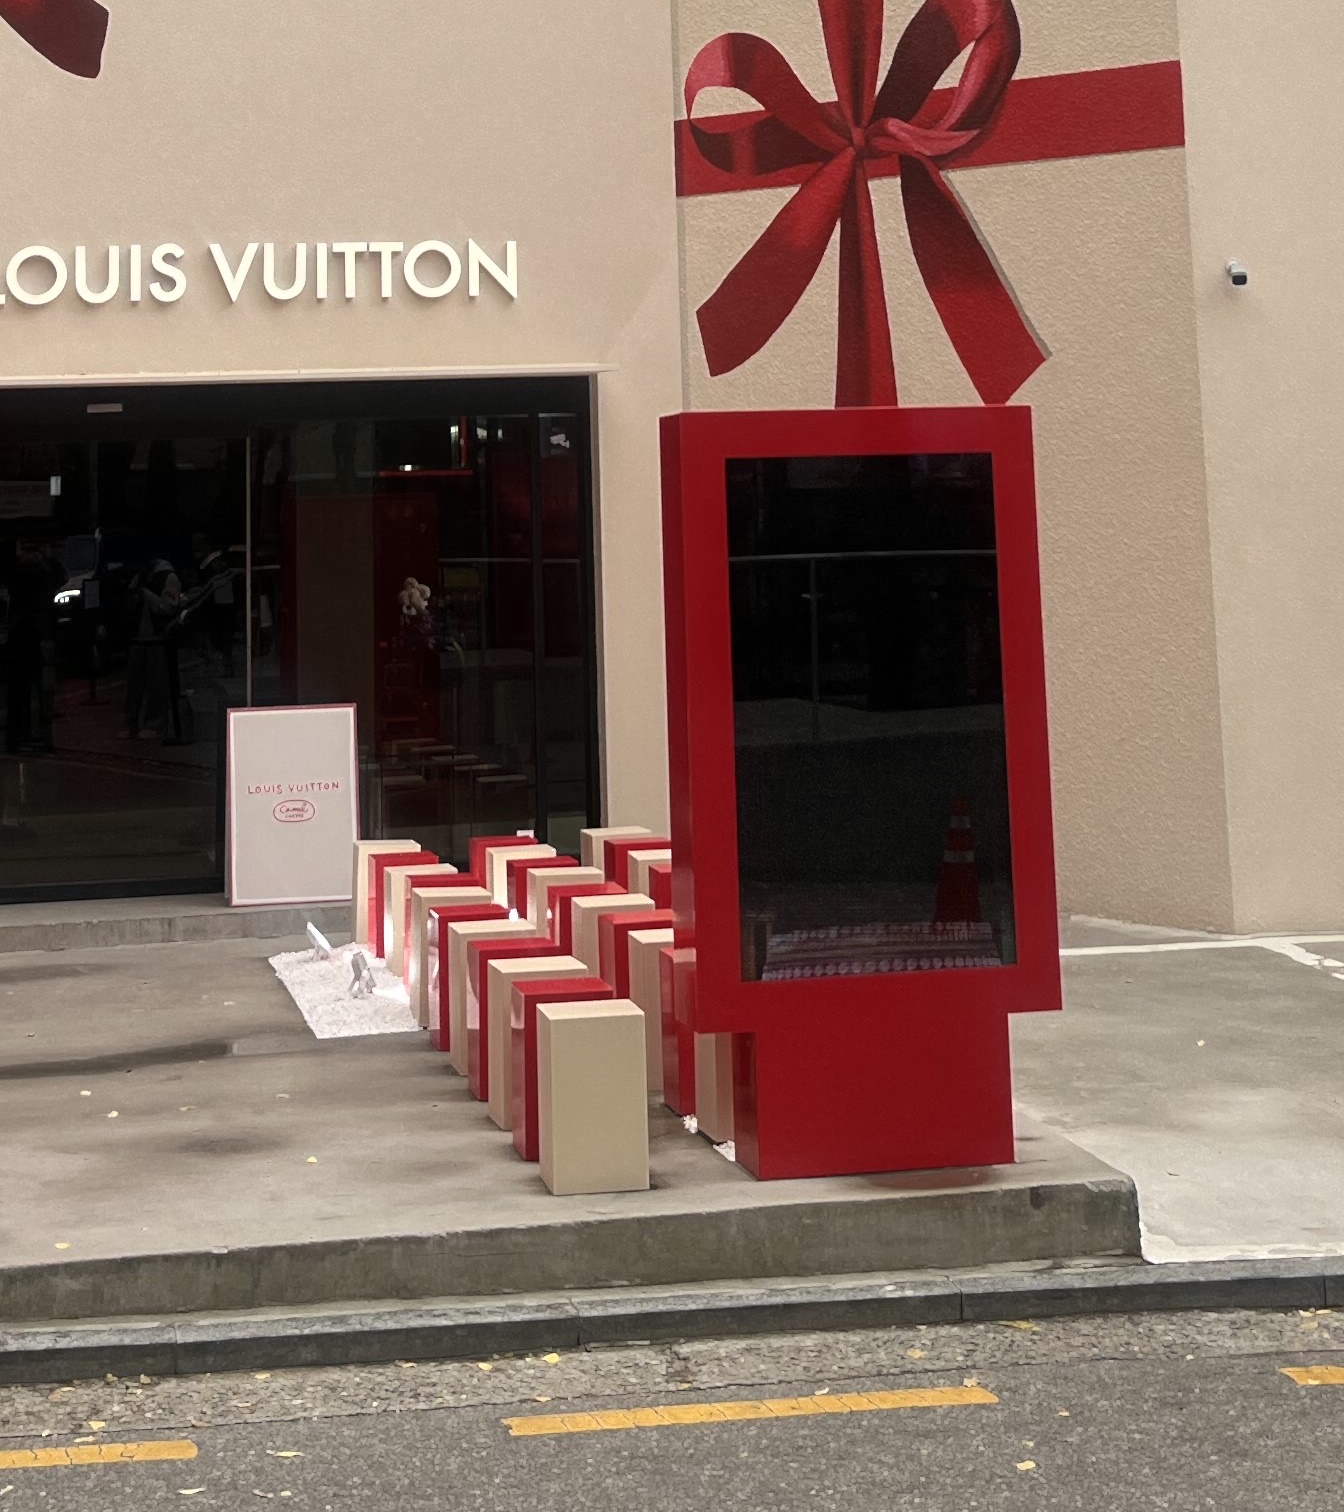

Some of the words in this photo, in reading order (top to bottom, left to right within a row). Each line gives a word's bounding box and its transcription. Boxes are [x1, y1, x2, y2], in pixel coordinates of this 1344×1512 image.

[208, 238, 518, 303] VUITTON
[247, 784, 284, 795] LOUIS
[287, 781, 339, 793] VUITTON
